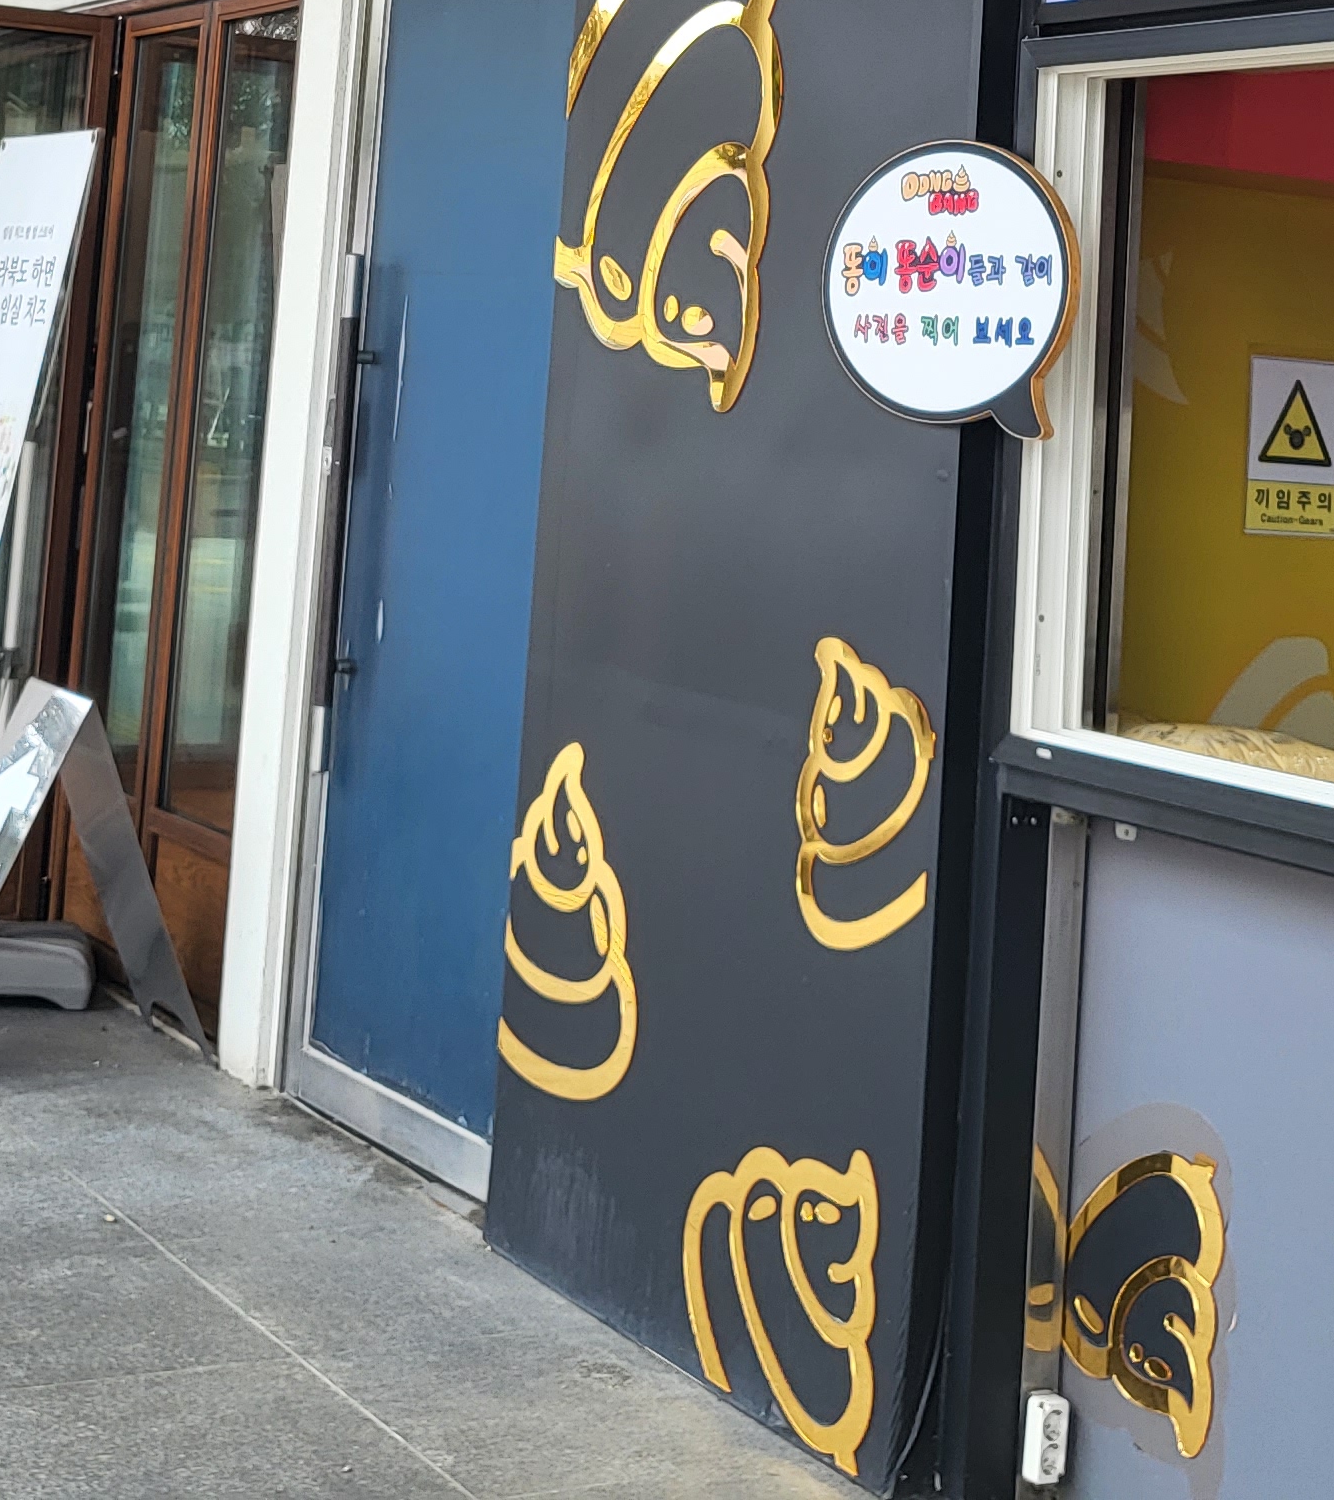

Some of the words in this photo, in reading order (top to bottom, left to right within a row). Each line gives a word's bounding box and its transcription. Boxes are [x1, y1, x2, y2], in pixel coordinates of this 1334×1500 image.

[929, 189, 980, 215] BANG
[32, 255, 57, 288] 하면
[1015, 254, 1053, 287] 같이
[0, 294, 23, 326] 임실
[24, 295, 47, 327] 치즈
[854, 313, 909, 345] 사진을
[921, 314, 960, 346] 찍어
[972, 315, 1035, 348] 보세요
